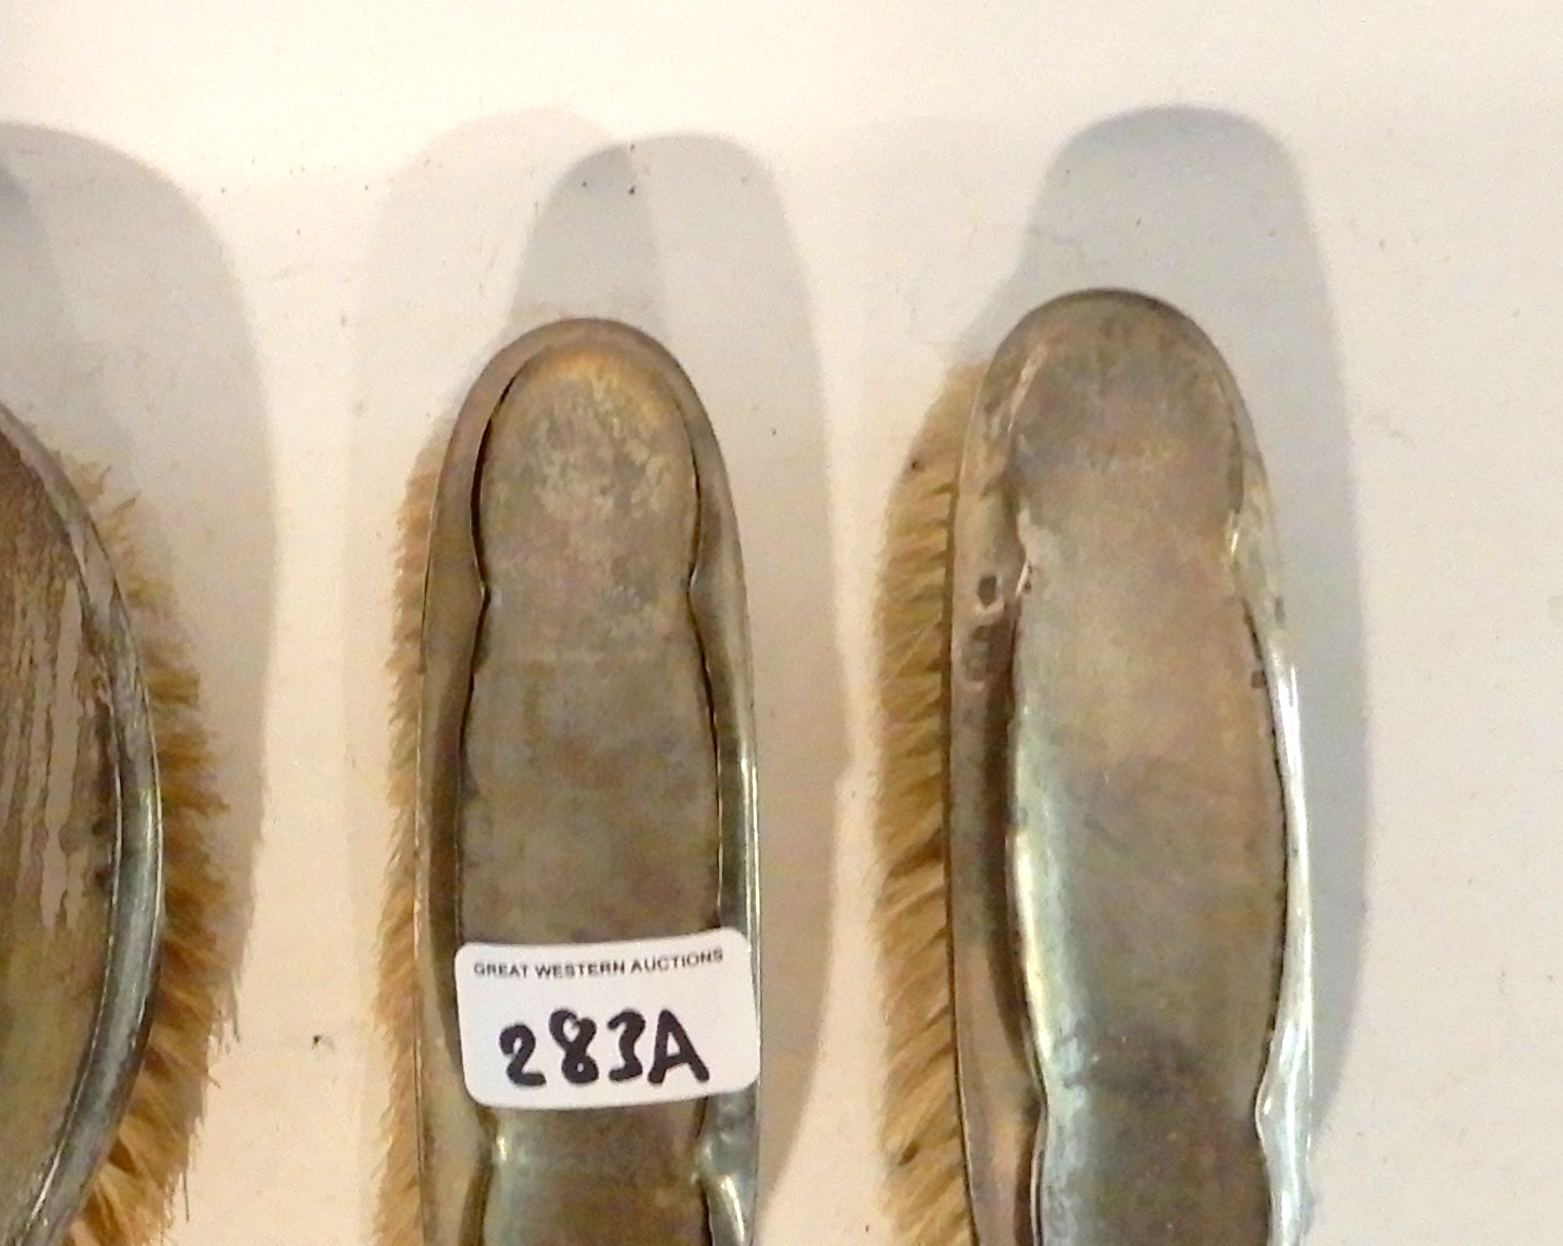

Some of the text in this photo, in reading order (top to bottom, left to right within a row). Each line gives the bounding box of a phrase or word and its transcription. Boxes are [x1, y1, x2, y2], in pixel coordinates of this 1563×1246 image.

[473, 946, 724, 979] GREAT WESTERN AUCTIONS
[498, 1008, 711, 1087] 283A
